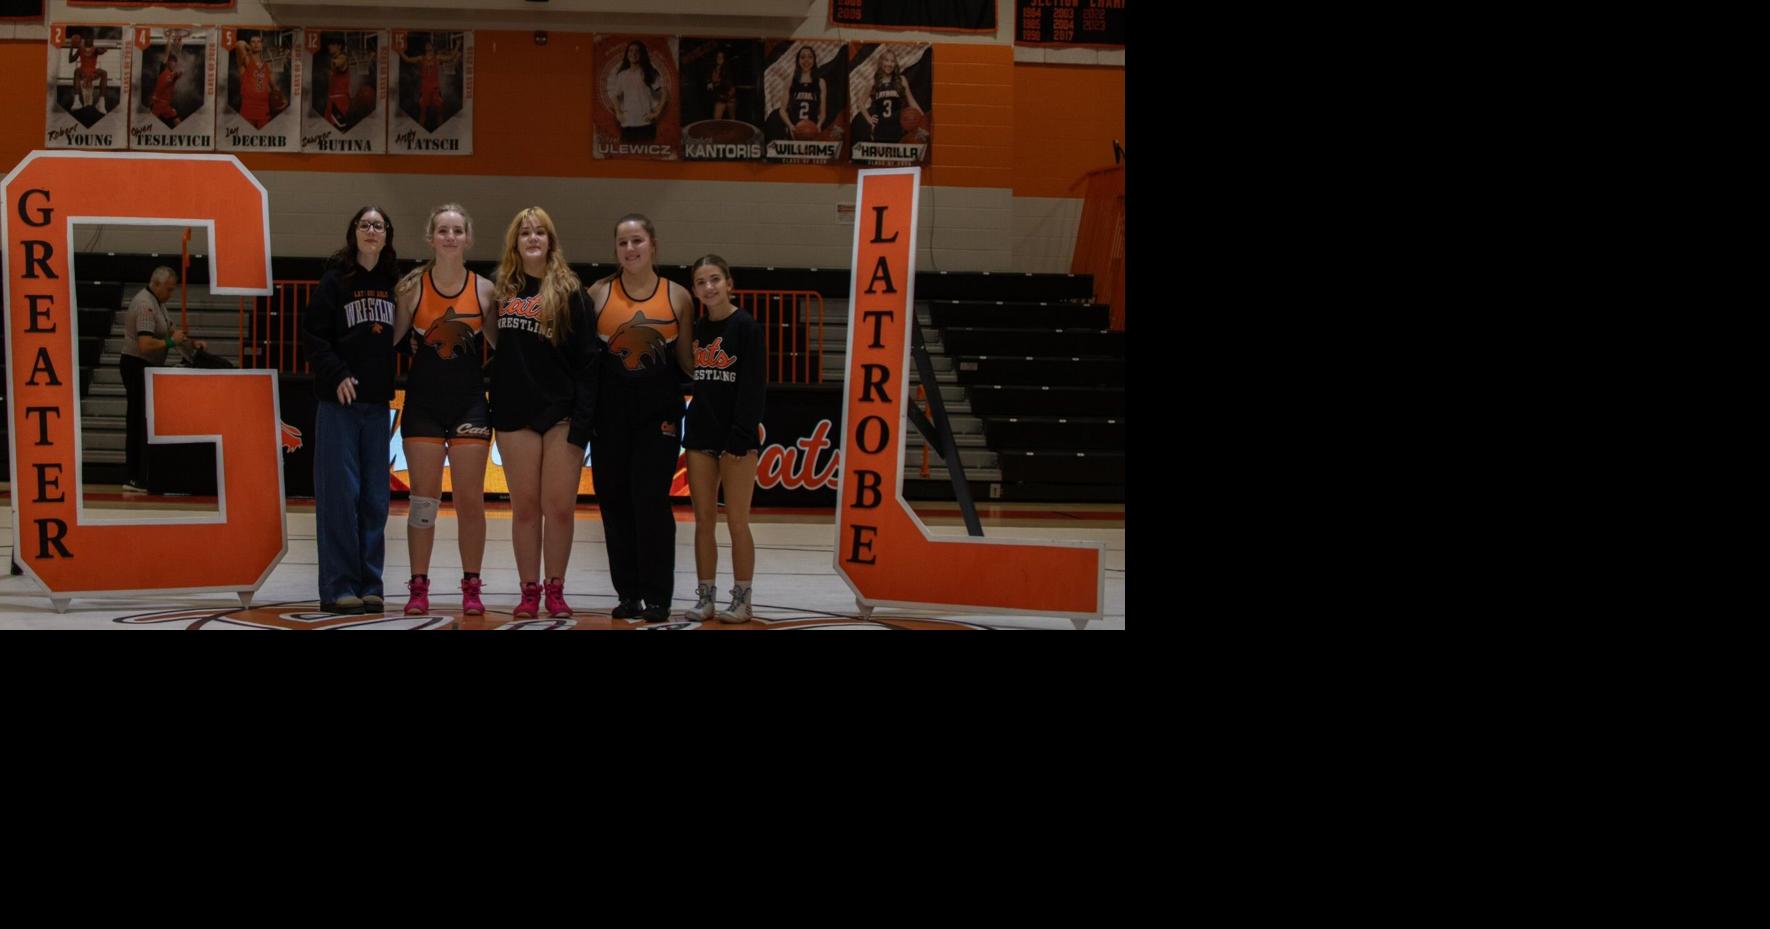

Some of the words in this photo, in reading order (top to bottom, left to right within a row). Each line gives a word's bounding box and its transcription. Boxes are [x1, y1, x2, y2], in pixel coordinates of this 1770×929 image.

[55, 28, 61, 43] 2
[139, 30, 146, 48] 4
[226, 31, 232, 46] 5
[308, 33, 318, 48] 12
[394, 34, 405, 49] 15
[1053, 30, 1074, 40] 2017
[800, 102, 809, 119] 2
[883, 100, 892, 118] 3
[66, 134, 113, 146] YOUNG
[136, 134, 211, 147] TESLEVICH
[232, 135, 287, 147] DECERB
[319, 139, 372, 151] BUTINA
[406, 138, 459, 151] TATSCH
[598, 143, 672, 155] ULEWICZ
[685, 144, 762, 158] KANTORIS
[775, 144, 836, 156] WILLIAMS
[861, 146, 919, 159] HAVRILLA
[344, 298, 395, 328] WRESTLIN
[692, 337, 737, 369] ats
[18, 189, 74, 560] GREATER
[694, 370, 737, 382] ESTLING
[845, 206, 899, 566] LATROBE
[456, 423, 490, 436] Cats
[756, 419, 841, 490] ats
